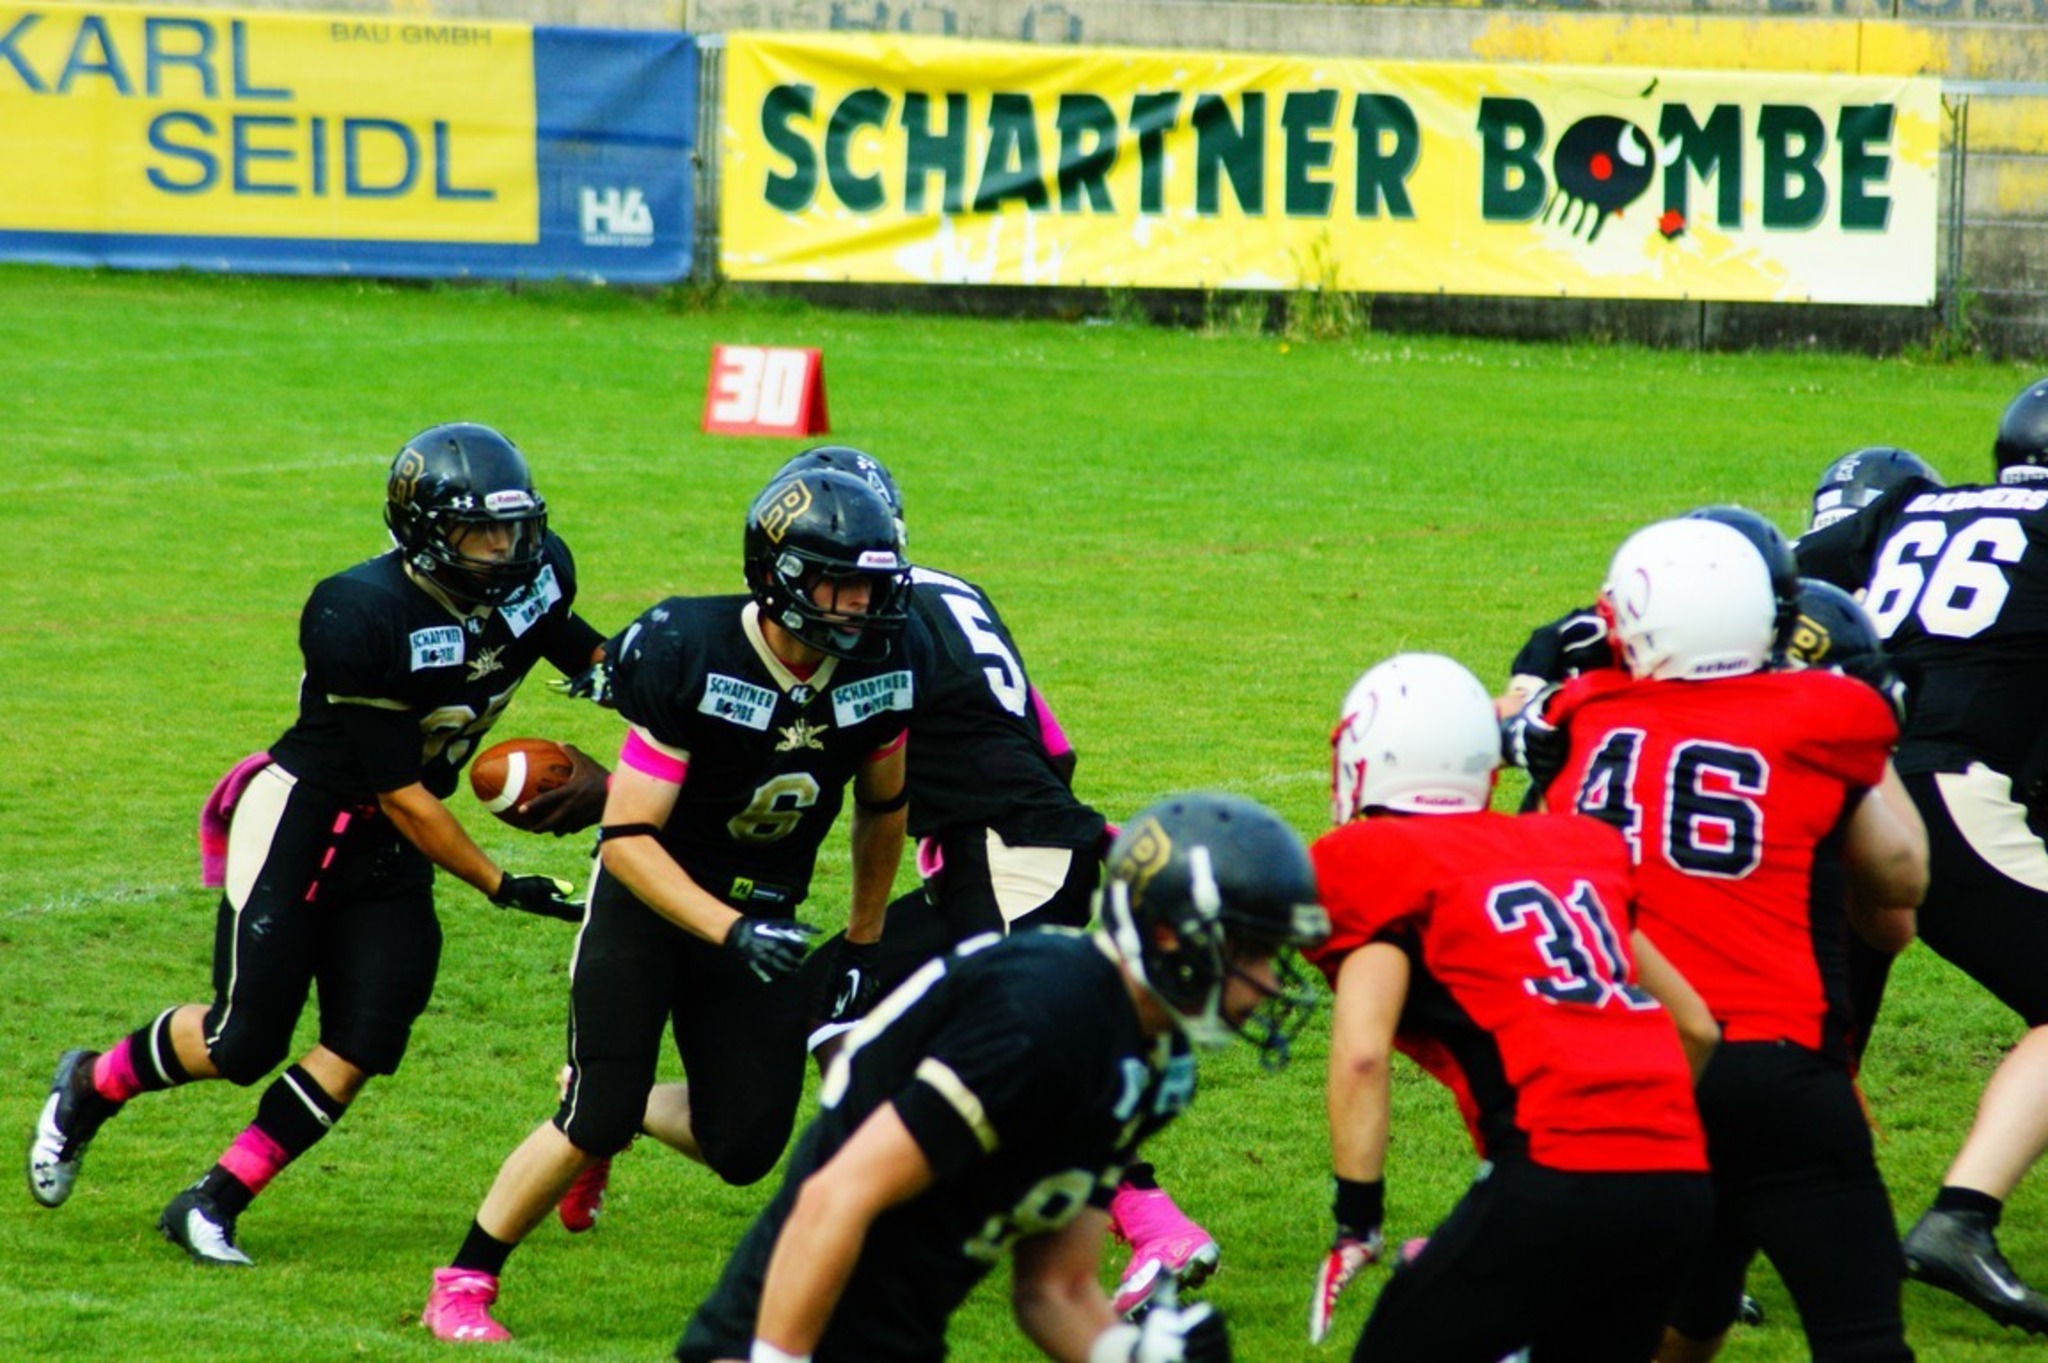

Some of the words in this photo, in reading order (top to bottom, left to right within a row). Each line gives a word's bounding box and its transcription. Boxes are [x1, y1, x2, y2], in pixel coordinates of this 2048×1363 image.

[0, 13, 295, 101] KARL
[331, 22, 390, 44] BAU
[402, 25, 492, 46] GMBH
[145, 109, 497, 201] SEIDL
[760, 83, 1421, 222] SCHARTNER
[1476, 95, 1897, 236] BOMBE
[714, 346, 807, 427] 30
[1863, 517, 2028, 639] 66
[708, 676, 775, 709] SCHARTNER
[835, 673, 909, 705] SCHARTNER
[940, 592, 1029, 718] 5
[727, 772, 820, 844] 6
[1575, 728, 1770, 880] 46
[1485, 878, 1663, 1011] 31
